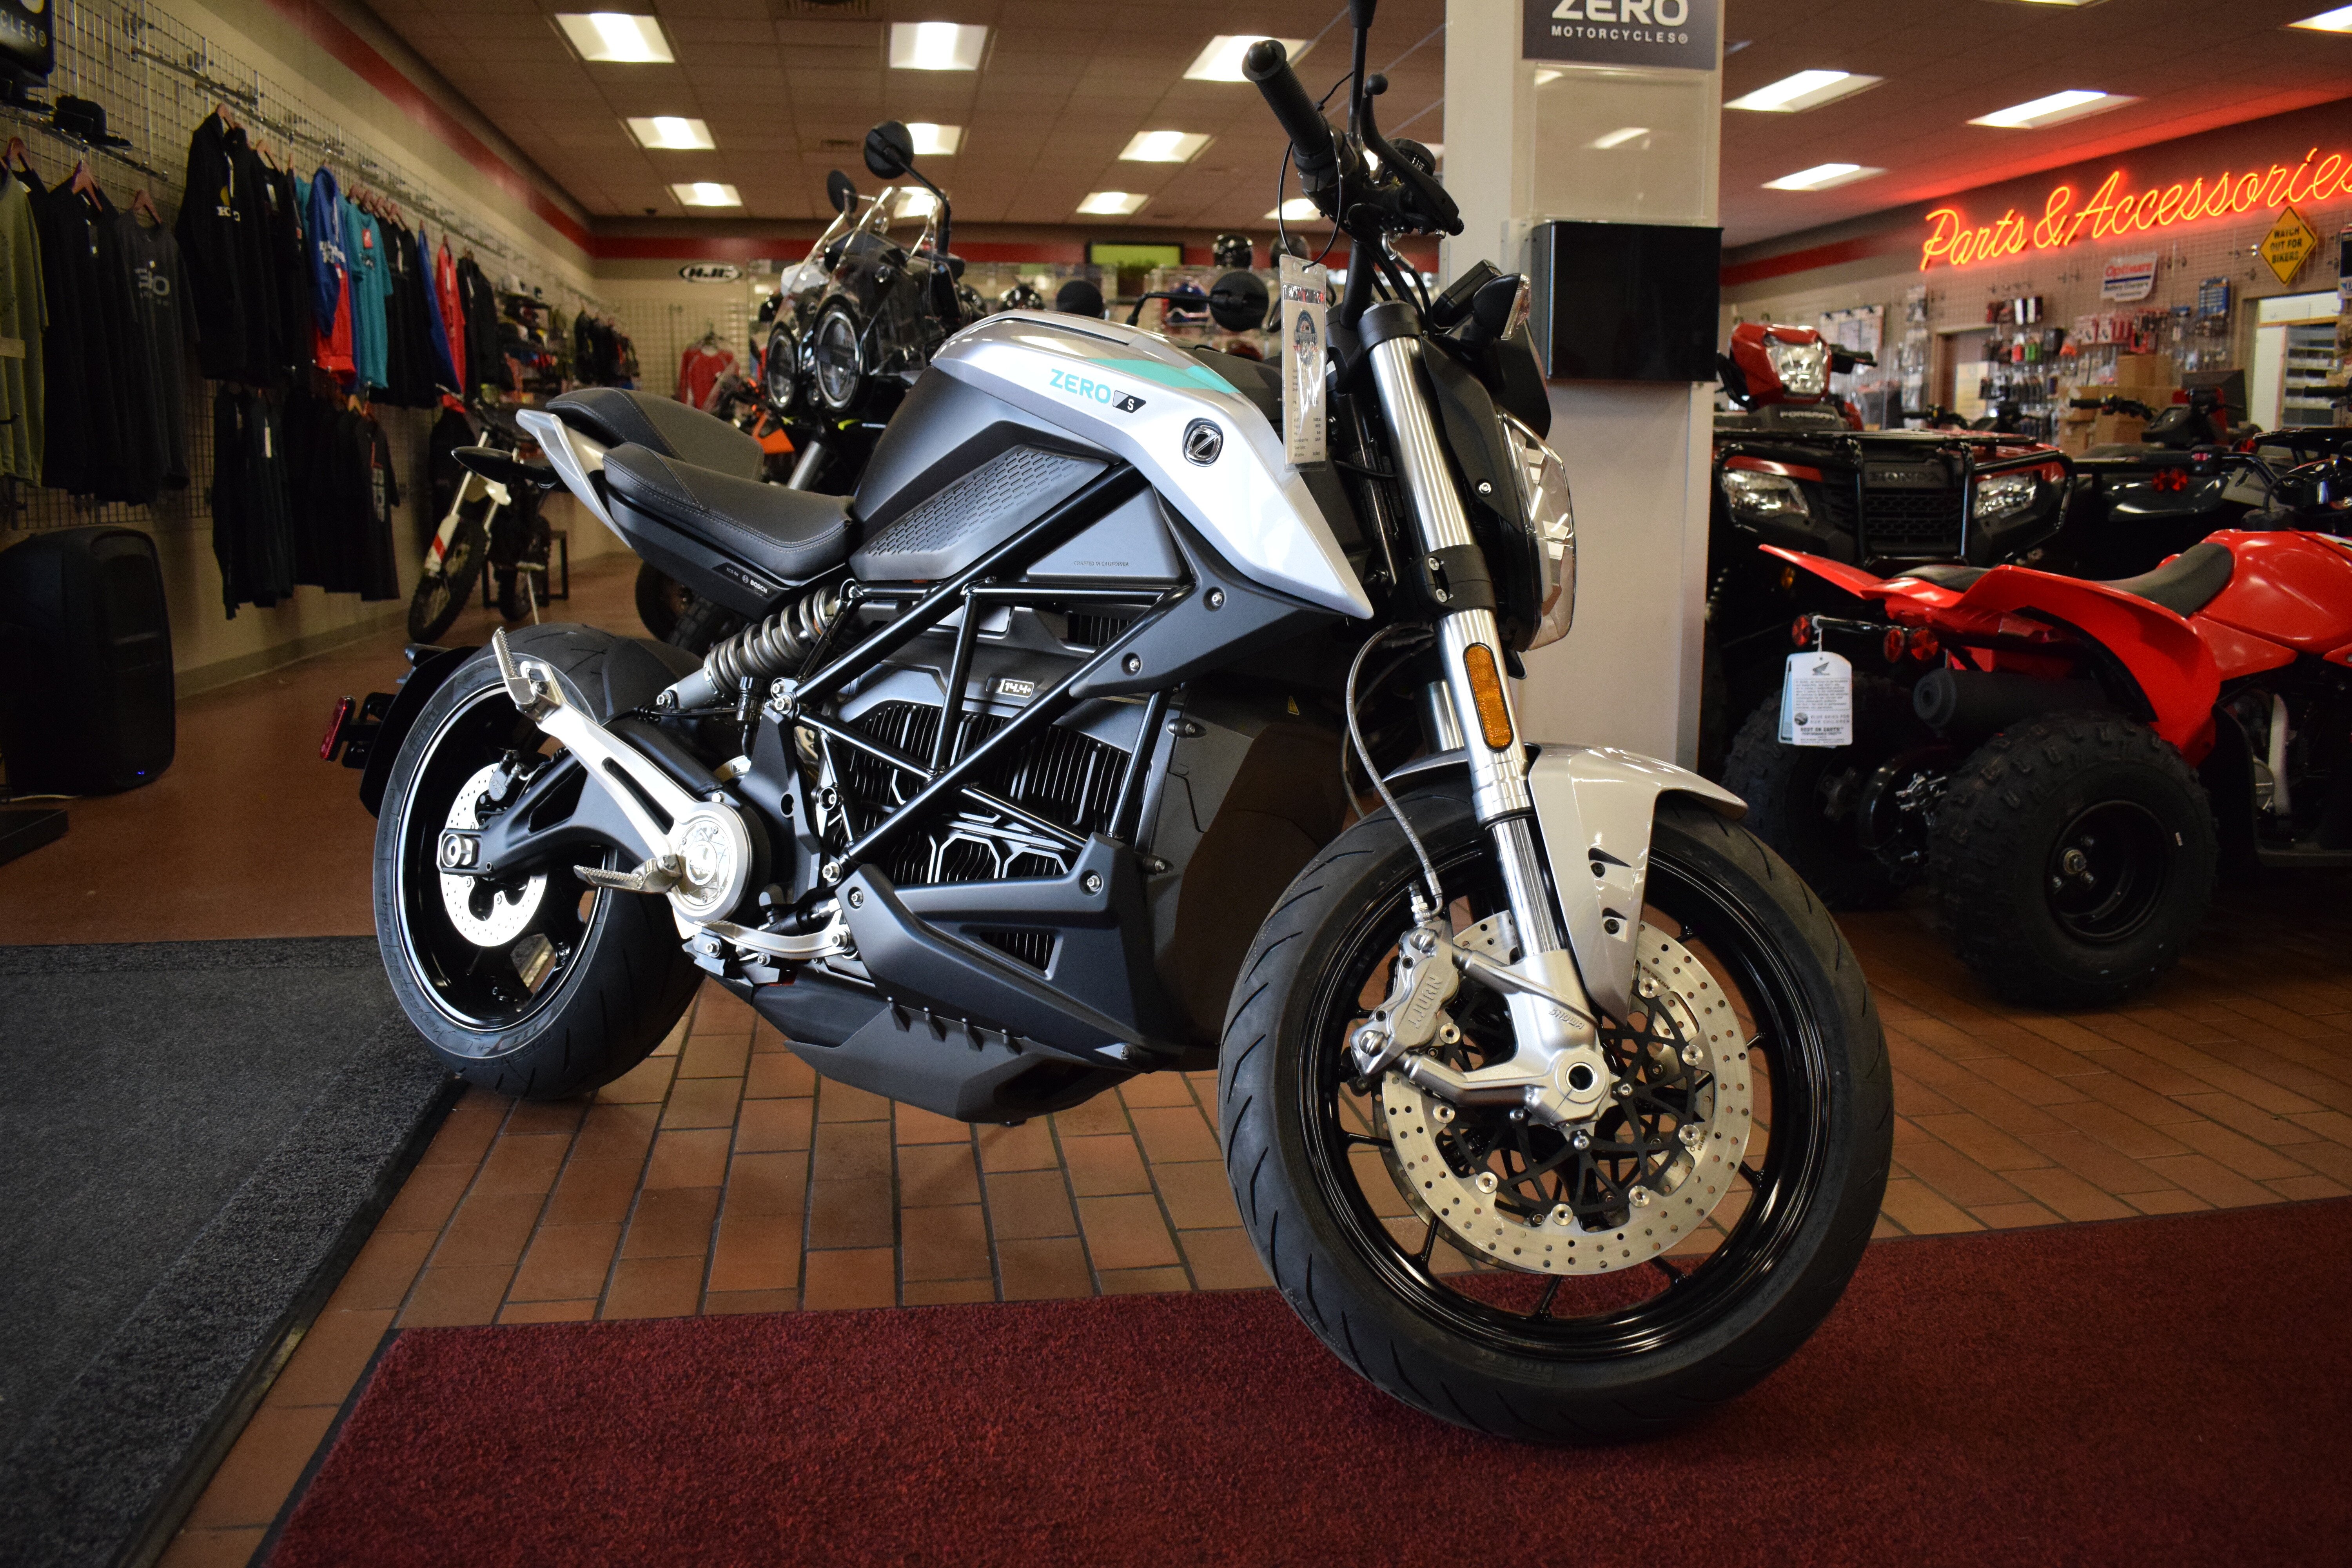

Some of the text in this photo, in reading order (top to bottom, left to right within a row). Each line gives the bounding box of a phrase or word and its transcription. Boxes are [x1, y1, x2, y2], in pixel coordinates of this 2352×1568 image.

[1920, 209, 2028, 271] Parts
[2033, 186, 2069, 249] &
[2274, 227, 2300, 239] WATCH
[2270, 238, 2302, 252] OUT FOR
[2272, 251, 2299, 264] BIKERS
[1050, 368, 1134, 411] ZERO S
[750, 579, 767, 593] BOSCH
[1005, 682, 1031, 694] 14.4+
[1402, 822, 1411, 833] SAE
[1548, 1007, 1585, 1030] SHOWA
